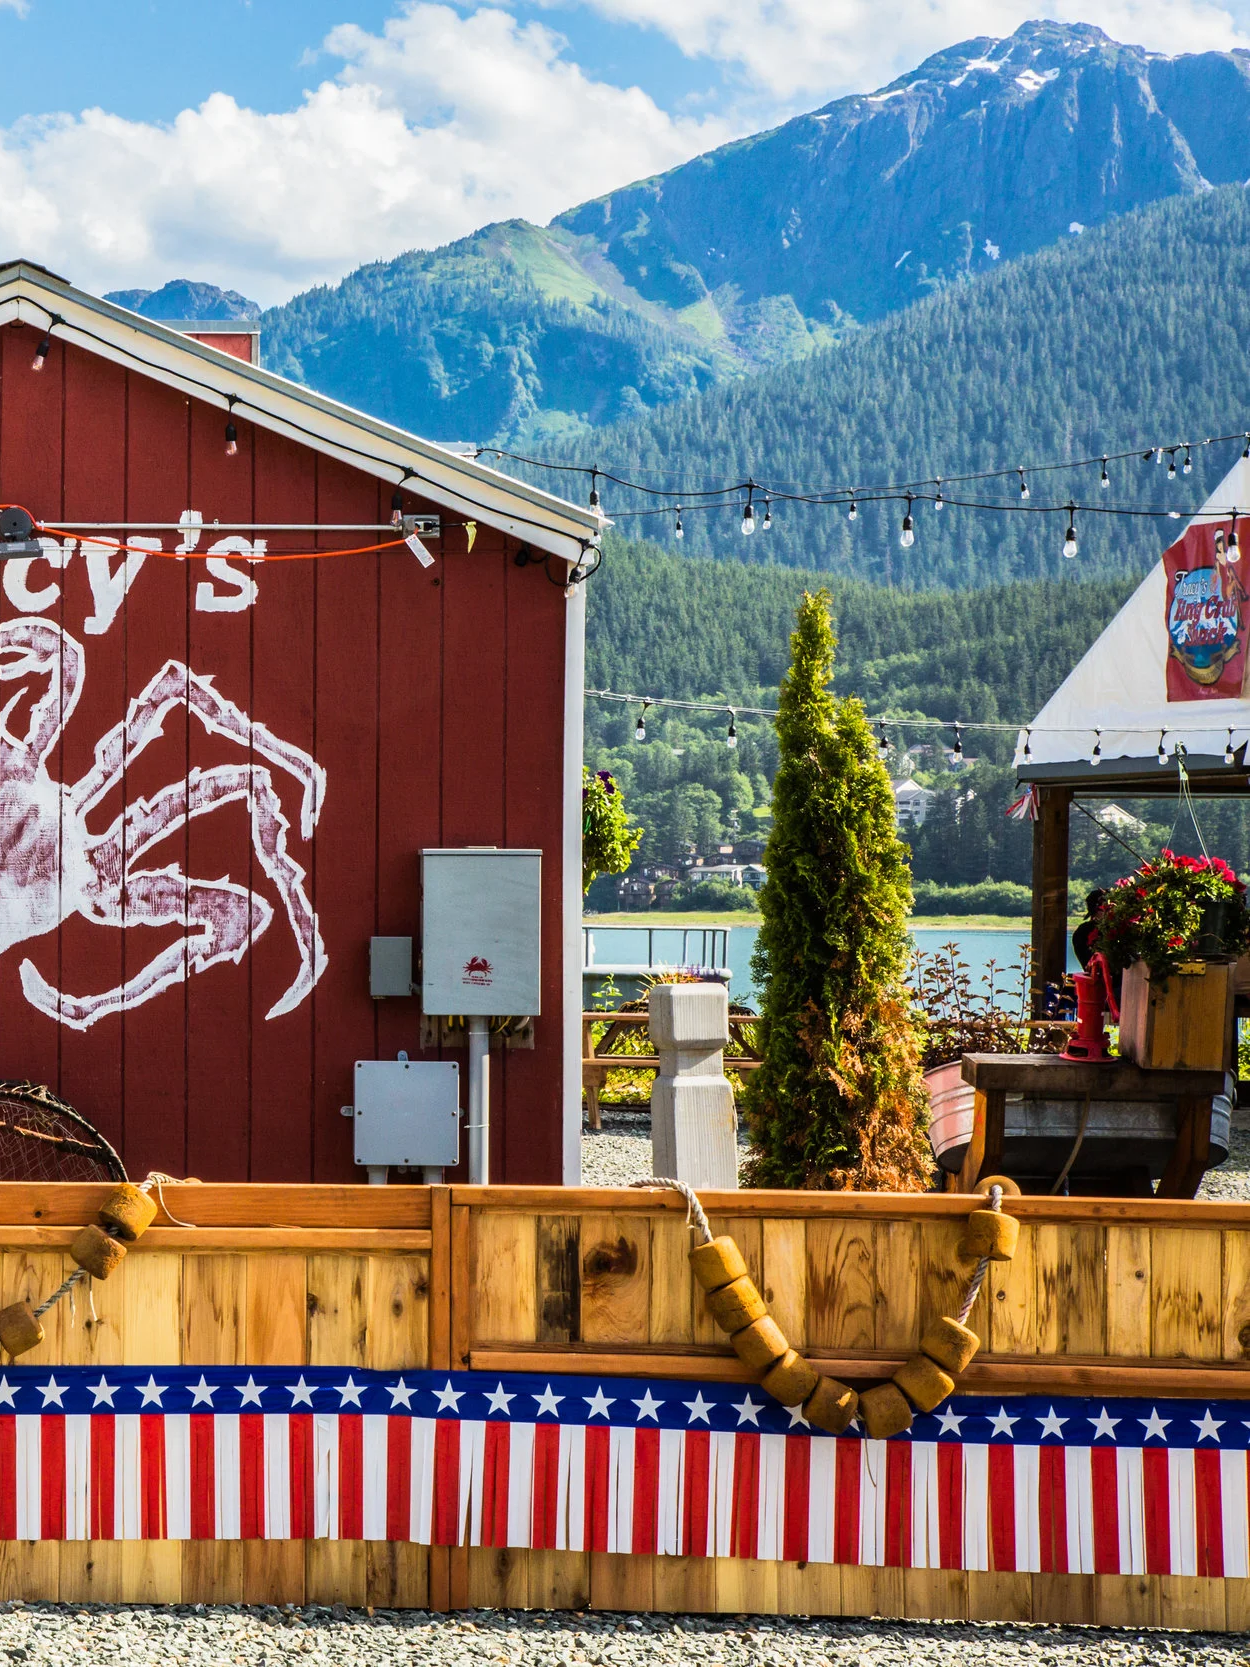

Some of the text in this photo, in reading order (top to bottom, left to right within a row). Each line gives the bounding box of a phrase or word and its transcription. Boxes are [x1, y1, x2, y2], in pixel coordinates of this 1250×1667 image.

[1174, 571, 1207, 596] Tracy's
[1174, 594, 1236, 622] King Crab
[1184, 621, 1227, 647] Shack
